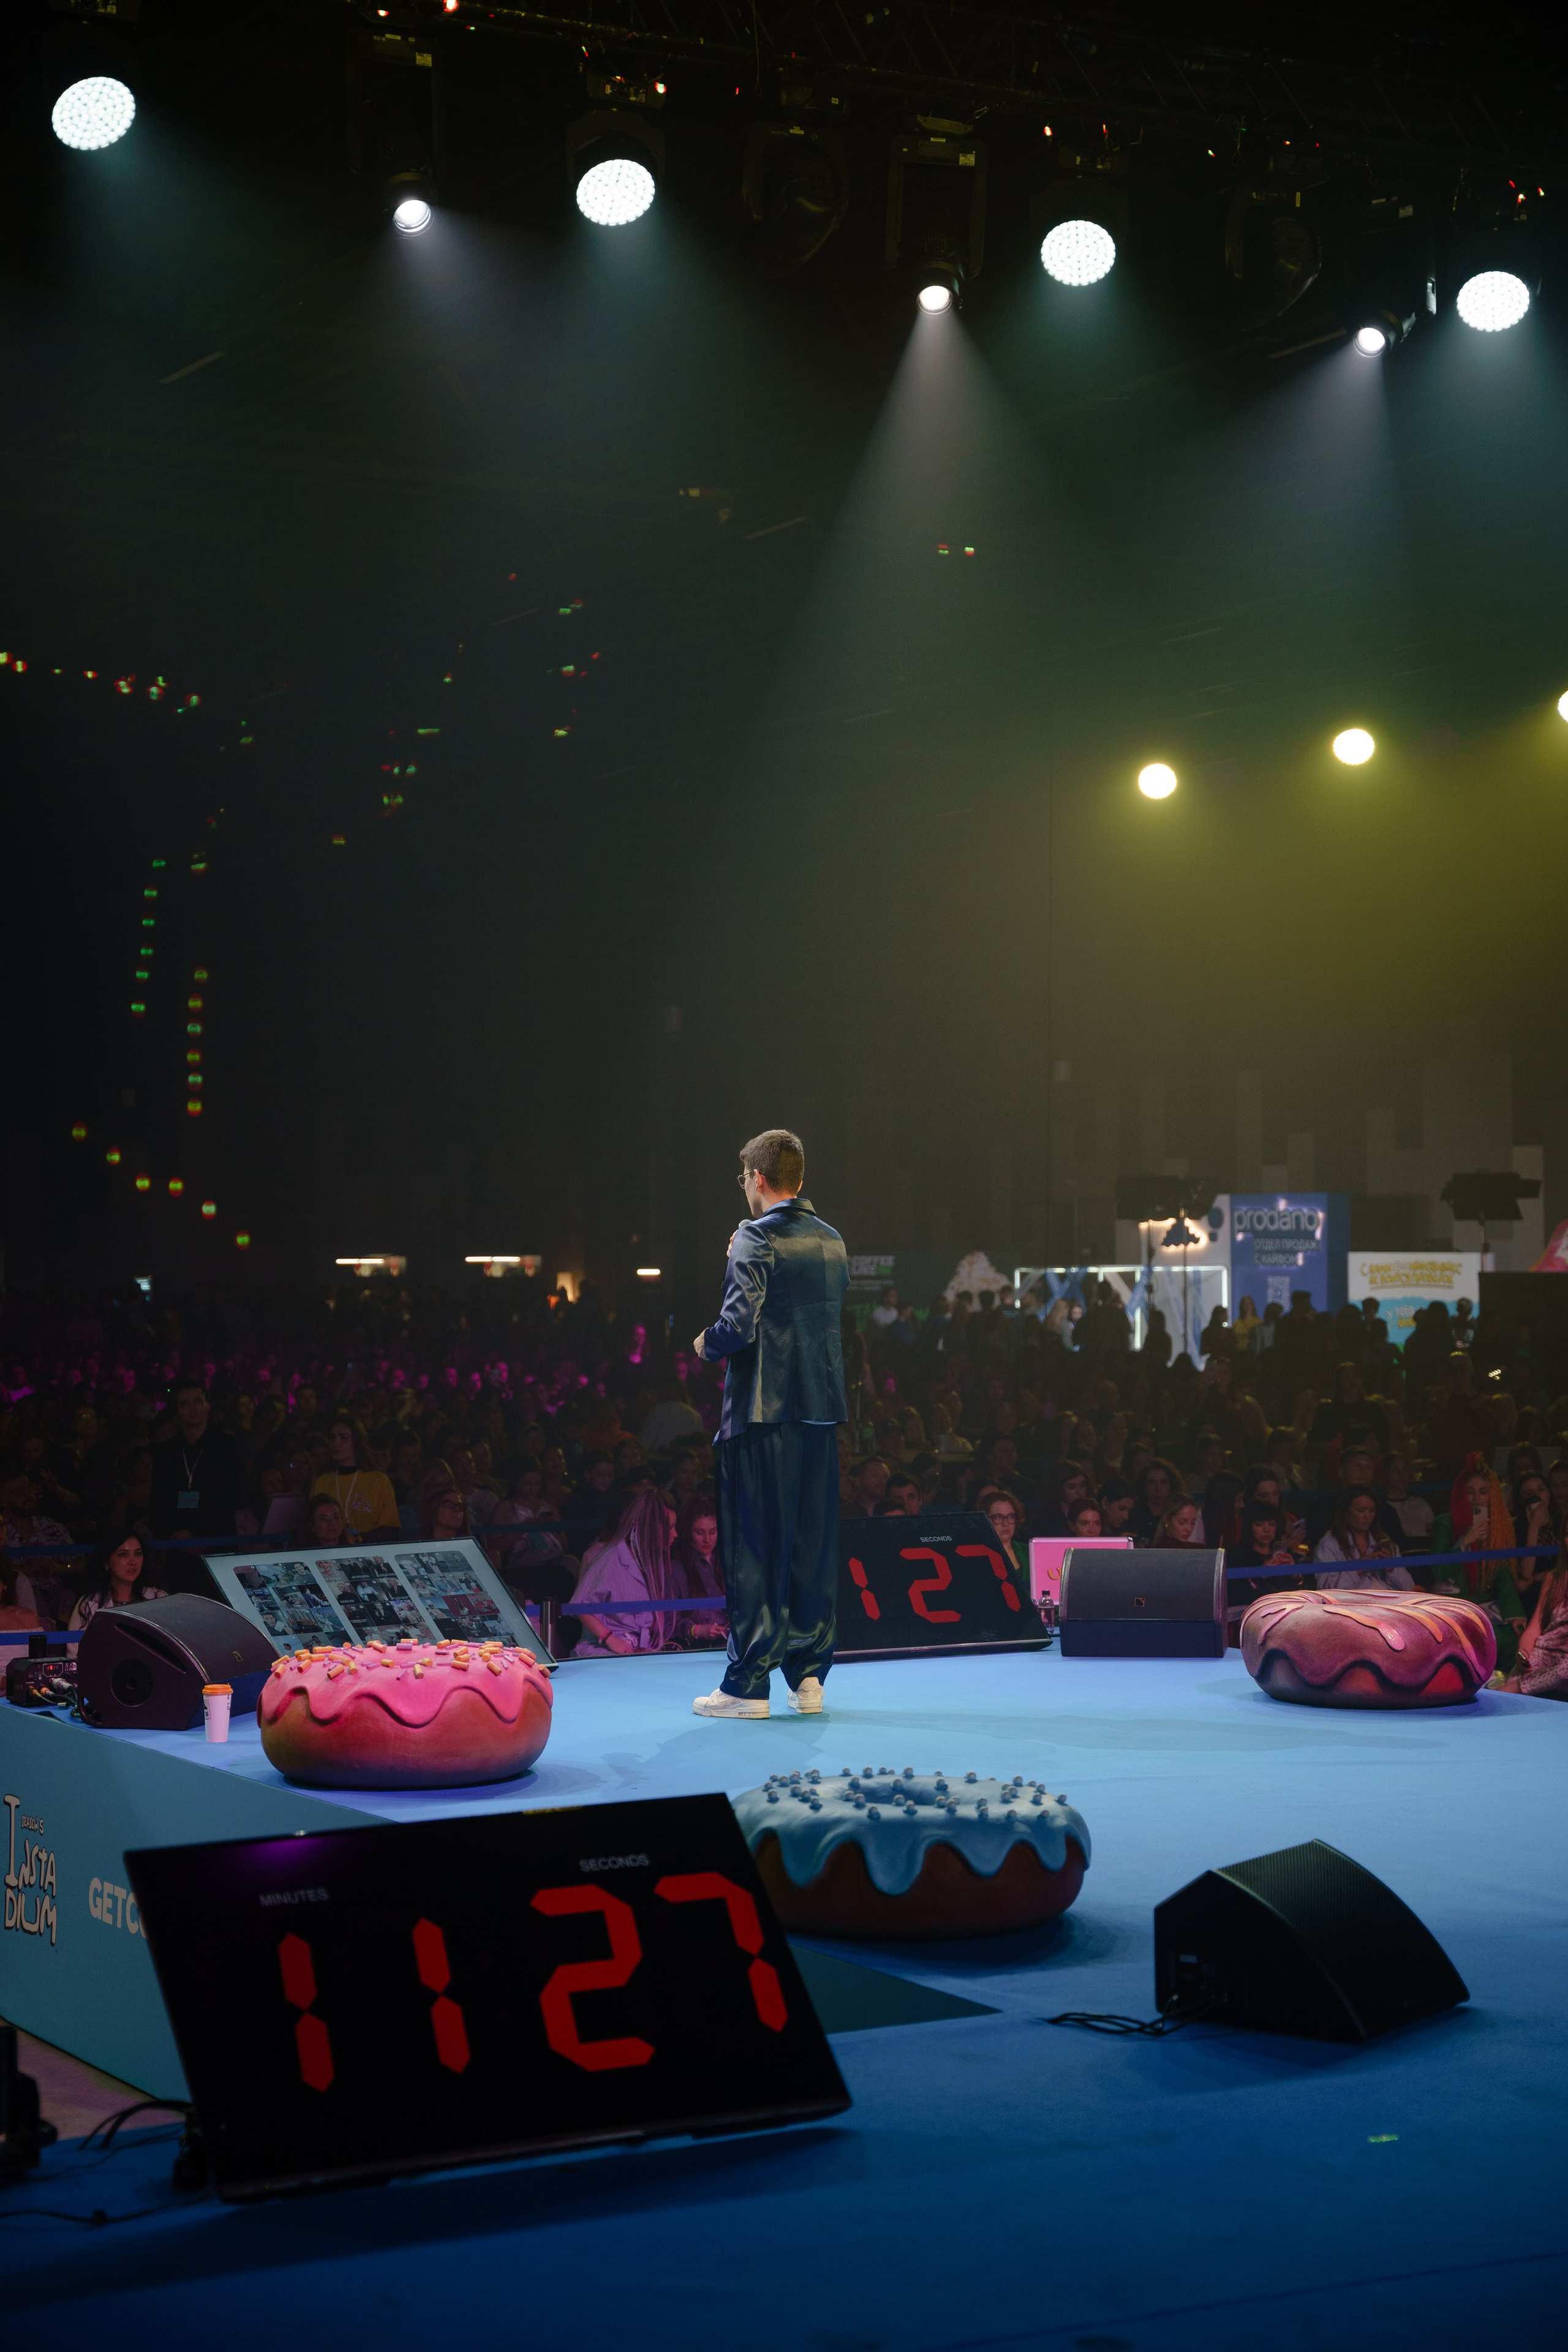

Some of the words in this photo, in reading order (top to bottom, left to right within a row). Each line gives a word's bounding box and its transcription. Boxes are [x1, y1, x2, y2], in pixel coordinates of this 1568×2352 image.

[1234, 1202, 1318, 1234] prodano
[1254, 1238, 1280, 1250] ОТДЕЛ
[1282, 1238, 1319, 1251] ПРОДАЖ
[900, 1545, 1020, 1623] 27
[39, 1819, 44, 1835] 5
[579, 1853, 650, 1872] SECONDS
[258, 1888, 329, 1907] MINUTES
[4, 1888, 58, 1946] DIUM
